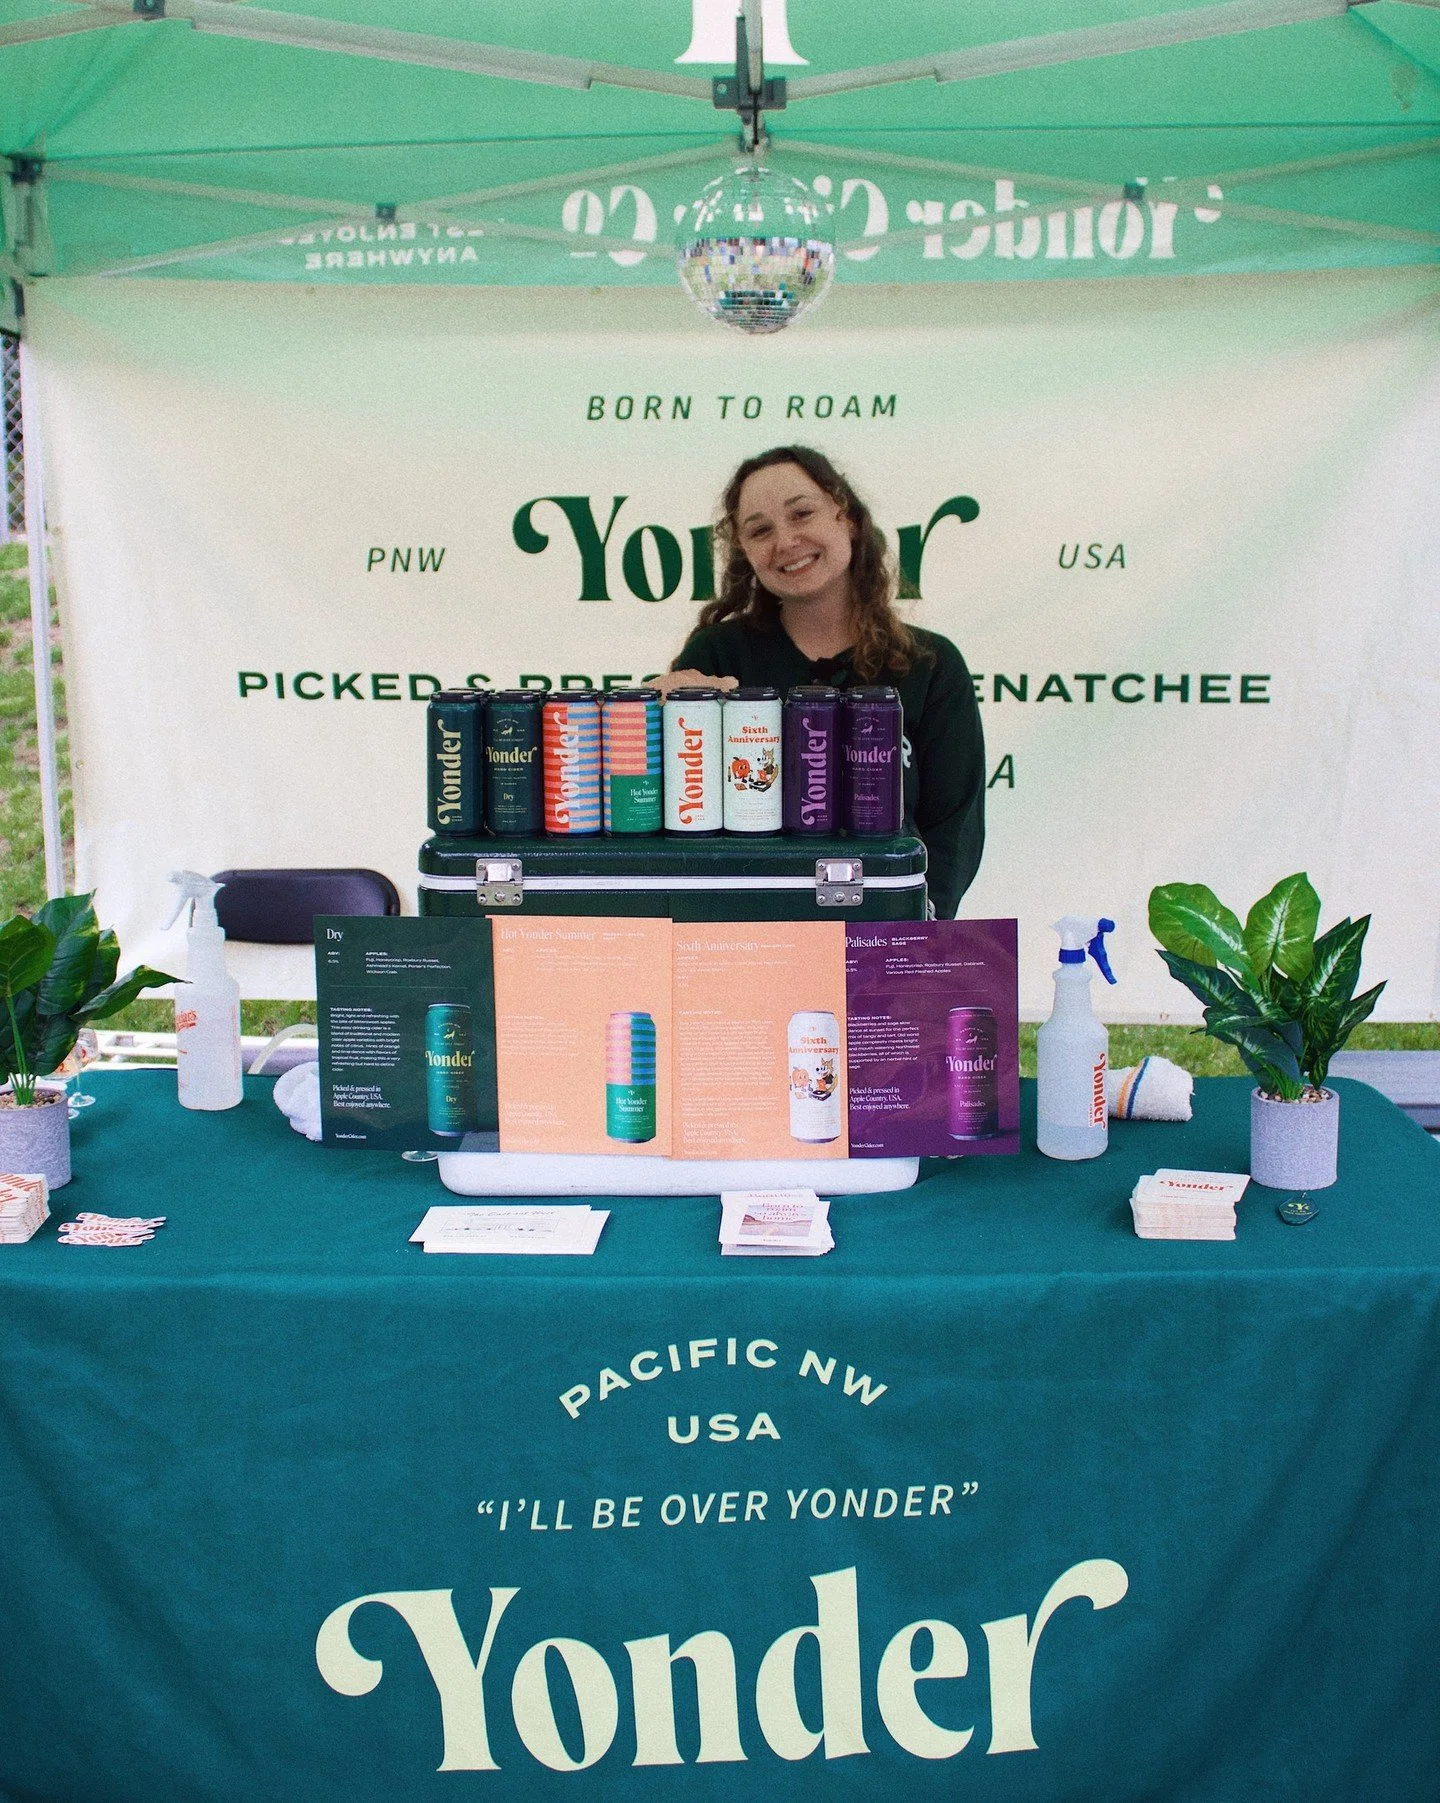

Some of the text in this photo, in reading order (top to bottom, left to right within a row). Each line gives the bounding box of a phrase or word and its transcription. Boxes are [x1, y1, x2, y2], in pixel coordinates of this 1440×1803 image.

[586, 394, 897, 421] BORN TO ROAM
[366, 546, 446, 573] PNW
[1058, 542, 1126, 569] USA
[238, 671, 442, 702] PICKED
[971, 672, 1271, 704] ENATCHEE
[741, 725, 768, 734] Sixth
[727, 734, 780, 745] Anniversary
[486, 745, 538, 764] Yonder
[843, 744, 897, 763] Yonder
[436, 718, 462, 825] Yonder
[553, 711, 580, 824] Yonder
[677, 716, 703, 825] Yonder
[800, 717, 827, 826] Yonder
[503, 791, 514, 802] Dry
[326, 928, 343, 942] Dry
[500, 928, 517, 940] Hot
[519, 928, 553, 940] Yonder
[555, 928, 596, 940] Summer
[845, 935, 887, 948] Palisades
[676, 940, 701, 951] Sixth
[704, 939, 760, 952] Anniversary
[800, 1036, 827, 1044] Sixth
[425, 1050, 475, 1067] Yonder
[946, 1054, 997, 1072] Yonder
[333, 1092, 348, 1101] Apple
[355, 1084, 375, 1093] pressed
[873, 1086, 894, 1095] pressed
[1093, 1053, 1106, 1129] Yonder
[850, 1095, 865, 1103] Apple
[866, 1095, 887, 1103] Country,
[862, 1102, 883, 1111] enjoyed
[884, 1102, 910, 1110] anywhere.
[1160, 1181, 1234, 1191] Yonder
[559, 1338, 888, 1420] PACIFIC NW
[667, 1412, 781, 1444] USA
[592, 1495, 643, 1530] BE
[660, 1490, 768, 1527] OVER
[314, 1558, 1130, 1773] Yonder
